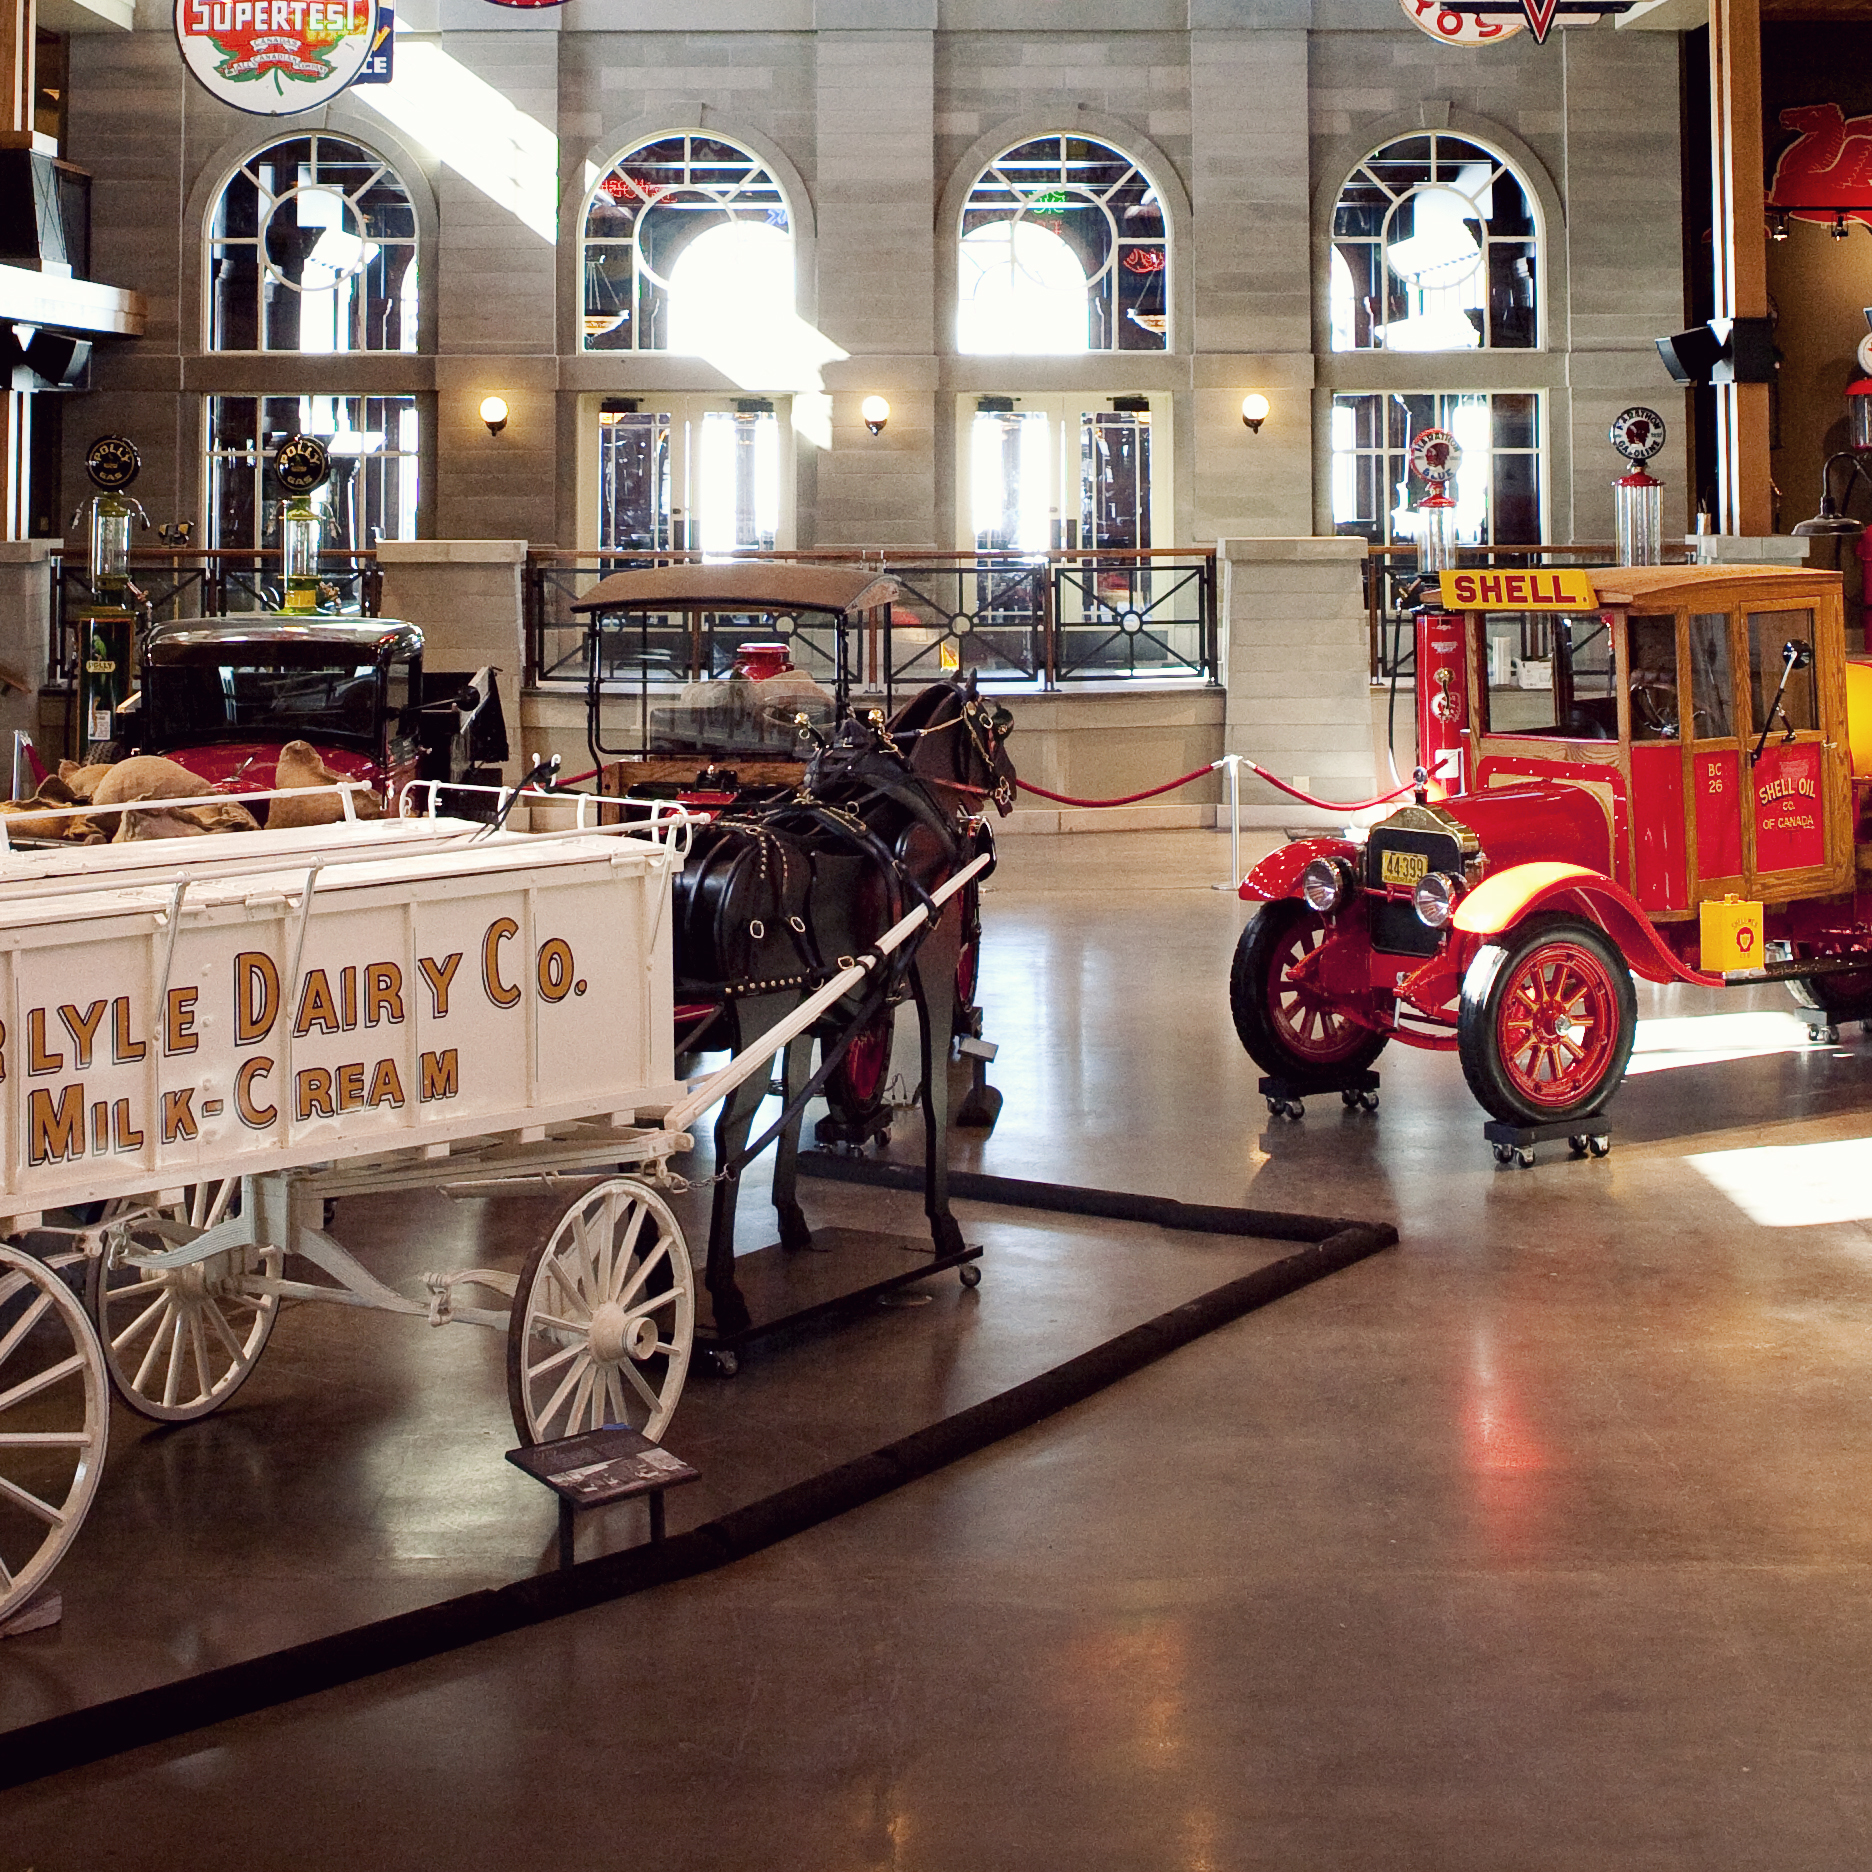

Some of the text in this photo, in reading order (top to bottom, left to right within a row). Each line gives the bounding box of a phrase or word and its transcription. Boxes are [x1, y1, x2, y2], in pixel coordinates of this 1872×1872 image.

[1616, 409, 1662, 432] MARATHON
[1414, 431, 1460, 453] MARATHON
[1617, 439, 1661, 459] GASOLINE
[93, 443, 132, 463] POLLY
[279, 442, 321, 465] POLLY
[99, 471, 123, 480] GAS
[287, 474, 313, 485] GAS
[1422, 467, 1454, 480] BLUE
[1707, 762, 1723, 777] BC
[1708, 779, 1723, 794] 26
[1758, 777, 1817, 806] SHELL OIL
[1762, 818, 1776, 830] OF
[1777, 814, 1814, 829] CANADA
[233, 948, 465, 1048] DAIRY
[479, 915, 592, 1012] CO.
[26, 1046, 461, 1170] MILK-CREAM
